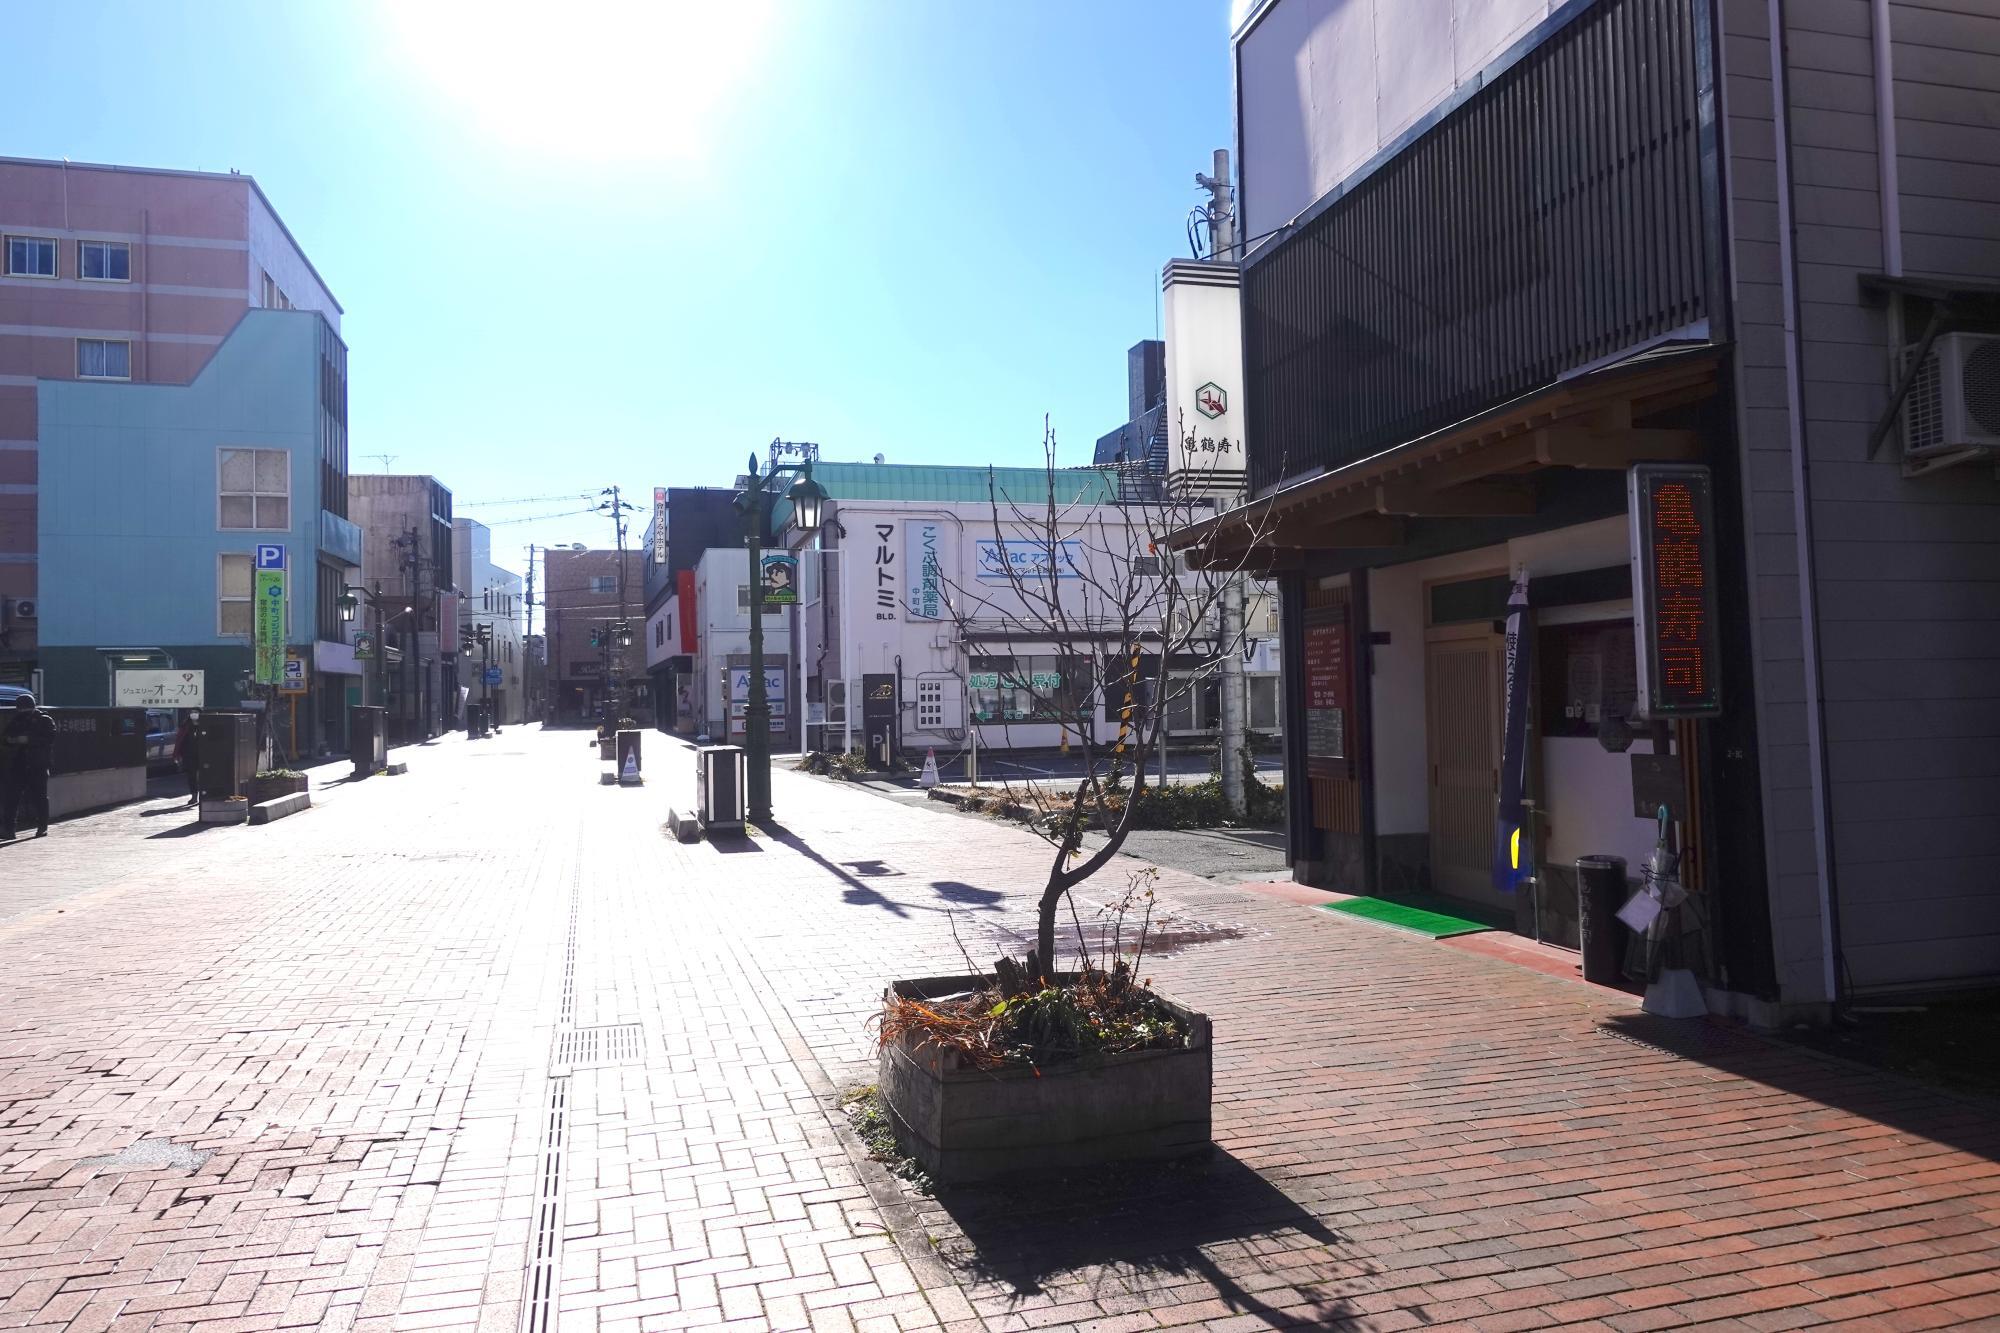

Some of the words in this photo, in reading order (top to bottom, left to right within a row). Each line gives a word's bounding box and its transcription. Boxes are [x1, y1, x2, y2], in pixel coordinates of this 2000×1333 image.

[261, 547, 280, 566] P
[875, 524, 895, 608] マルトミ
[922, 526, 938, 617] こくぶ調剤薬局
[872, 734, 883, 749] P
